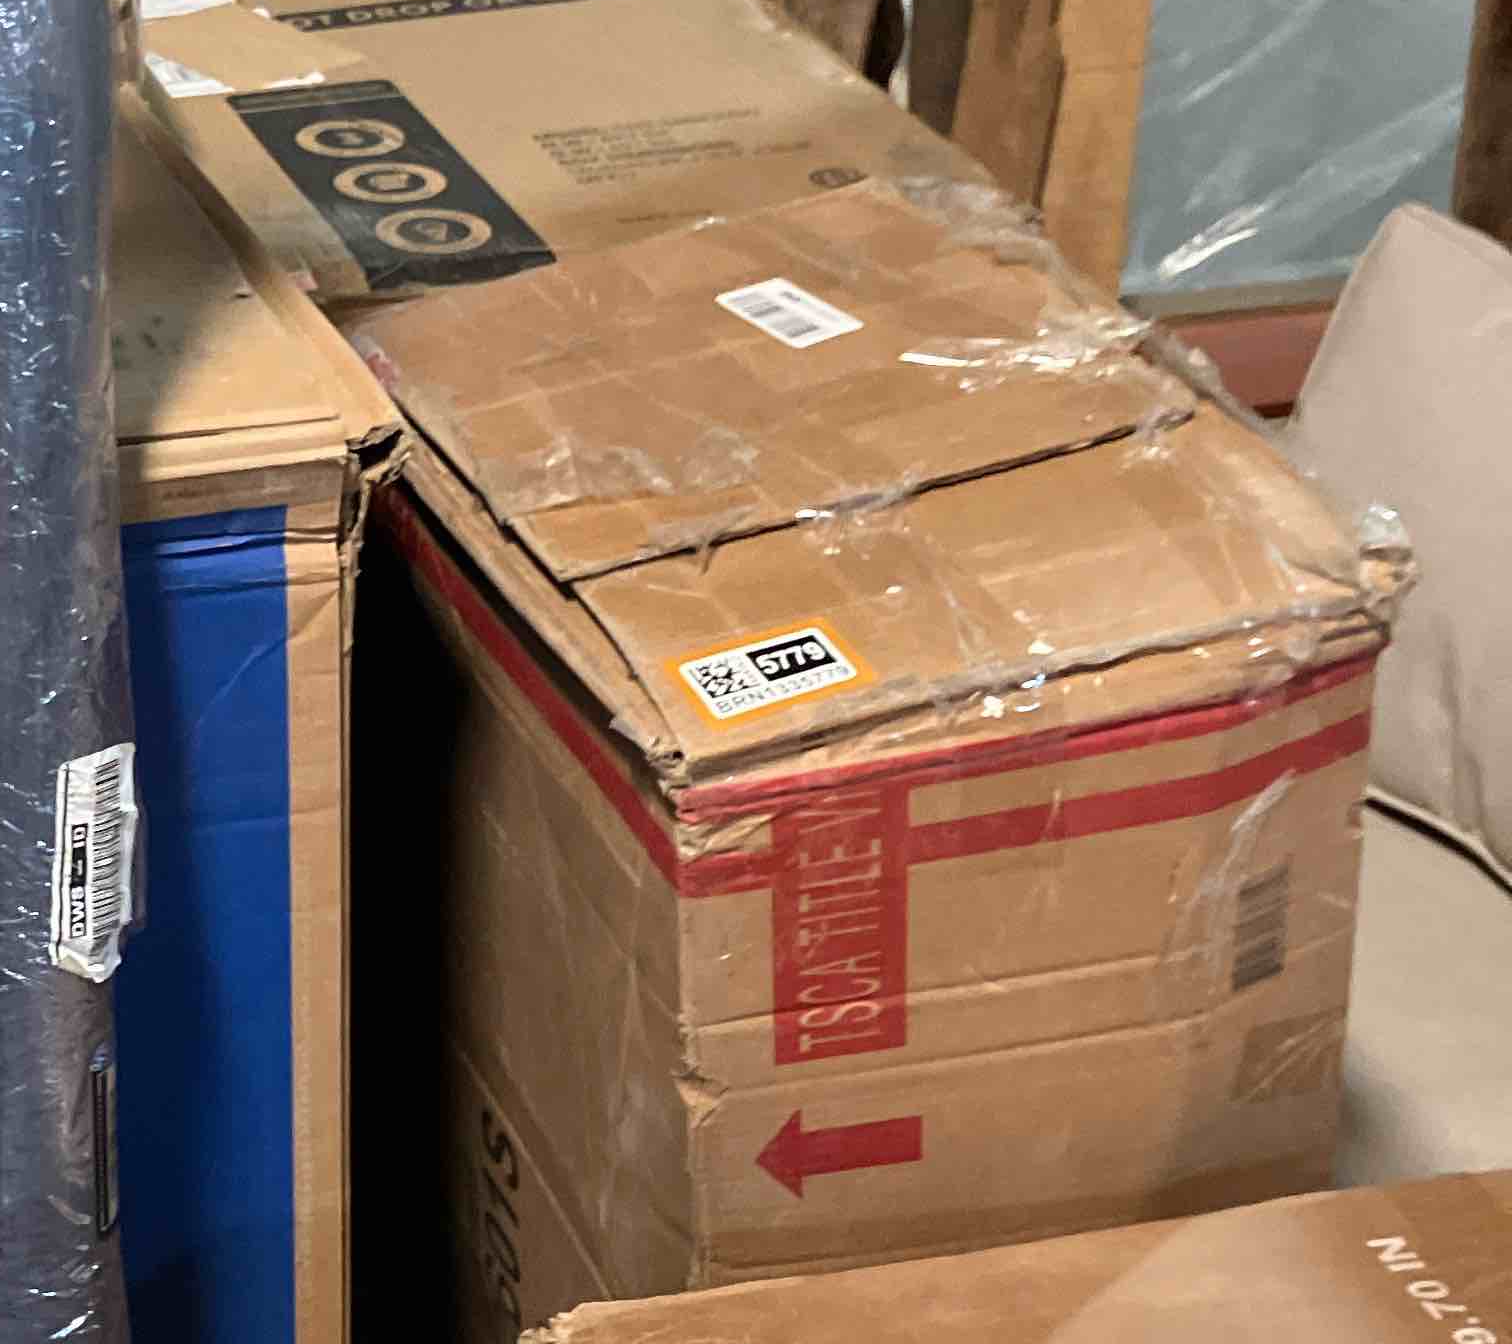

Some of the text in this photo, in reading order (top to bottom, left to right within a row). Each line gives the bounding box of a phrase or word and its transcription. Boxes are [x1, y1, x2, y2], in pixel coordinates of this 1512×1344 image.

[754, 640, 828, 676] 5779
[797, 838, 882, 947] TITLE
[797, 952, 883, 1053] TSCA
[1365, 1235, 1426, 1273] IN
